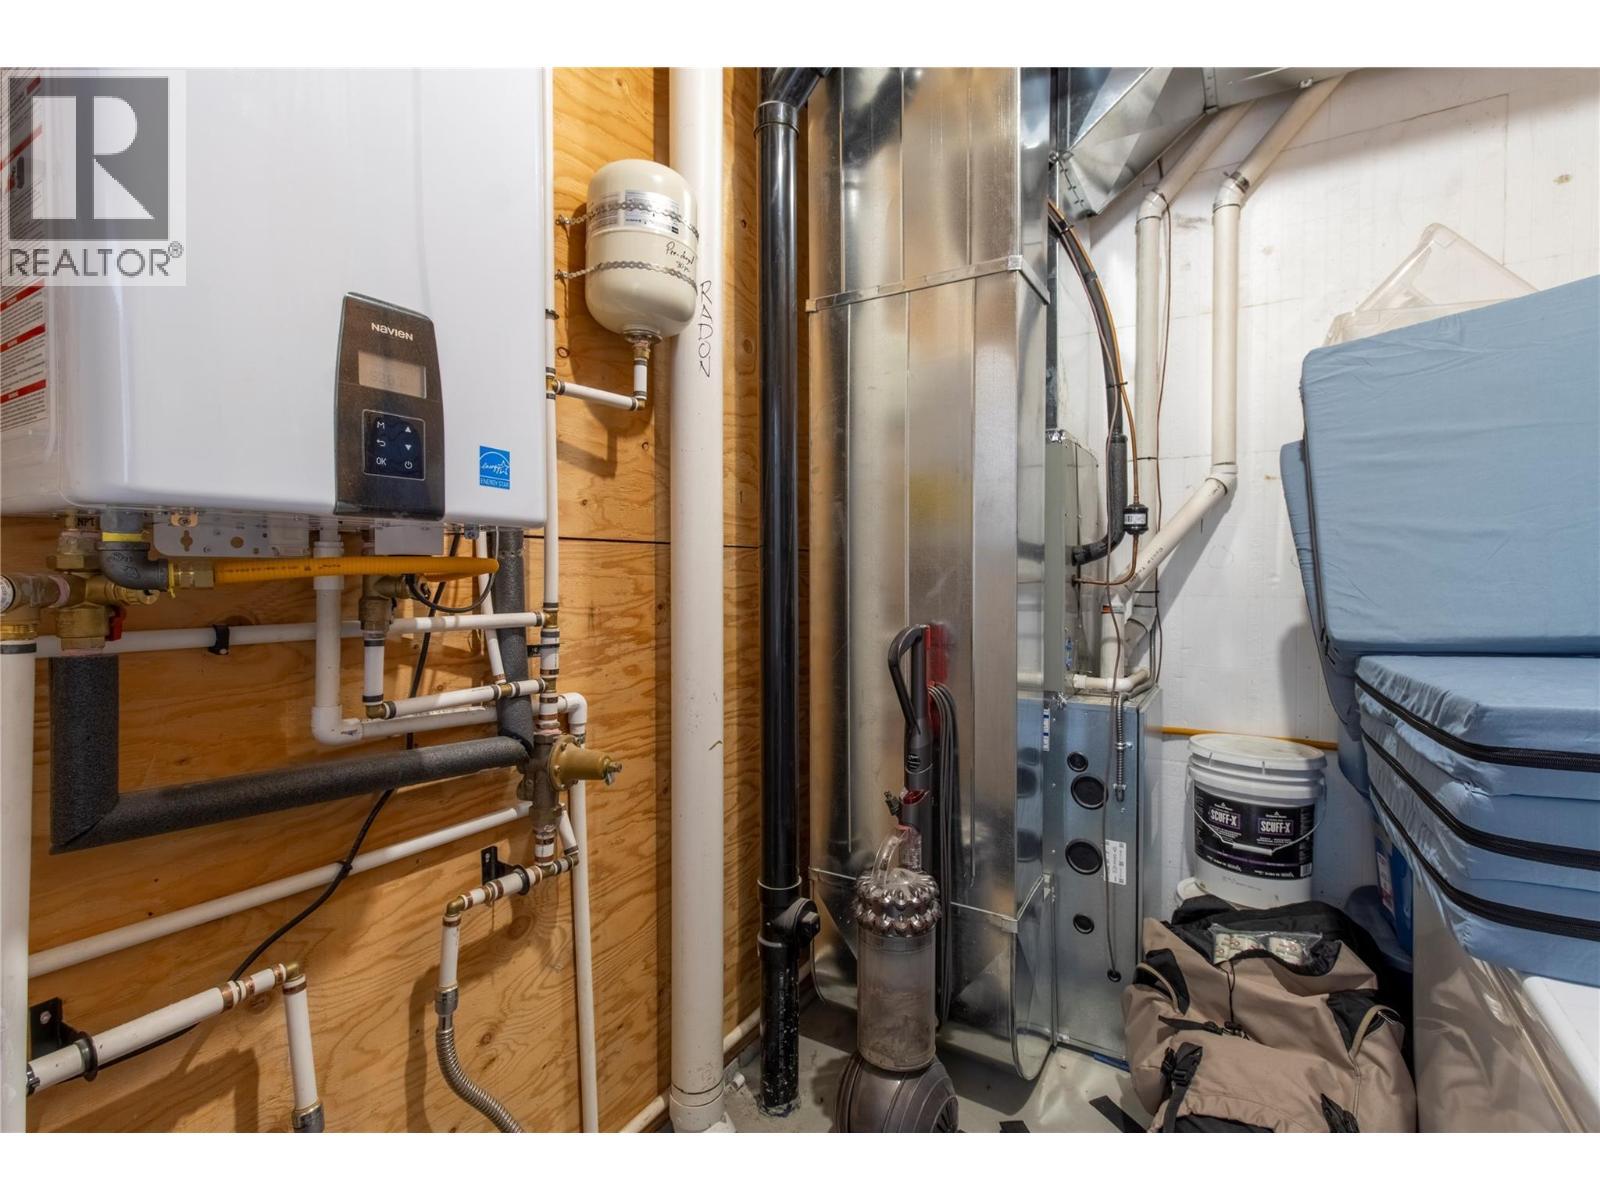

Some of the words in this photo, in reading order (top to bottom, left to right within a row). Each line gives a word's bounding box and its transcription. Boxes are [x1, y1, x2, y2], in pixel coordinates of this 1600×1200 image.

[698, 280, 714, 378] RADON
[376, 421, 385, 429] M
[376, 456, 387, 466] OK
[1210, 808, 1237, 827] SCUFF-X
[1260, 820, 1291, 833] SCUFF-X
